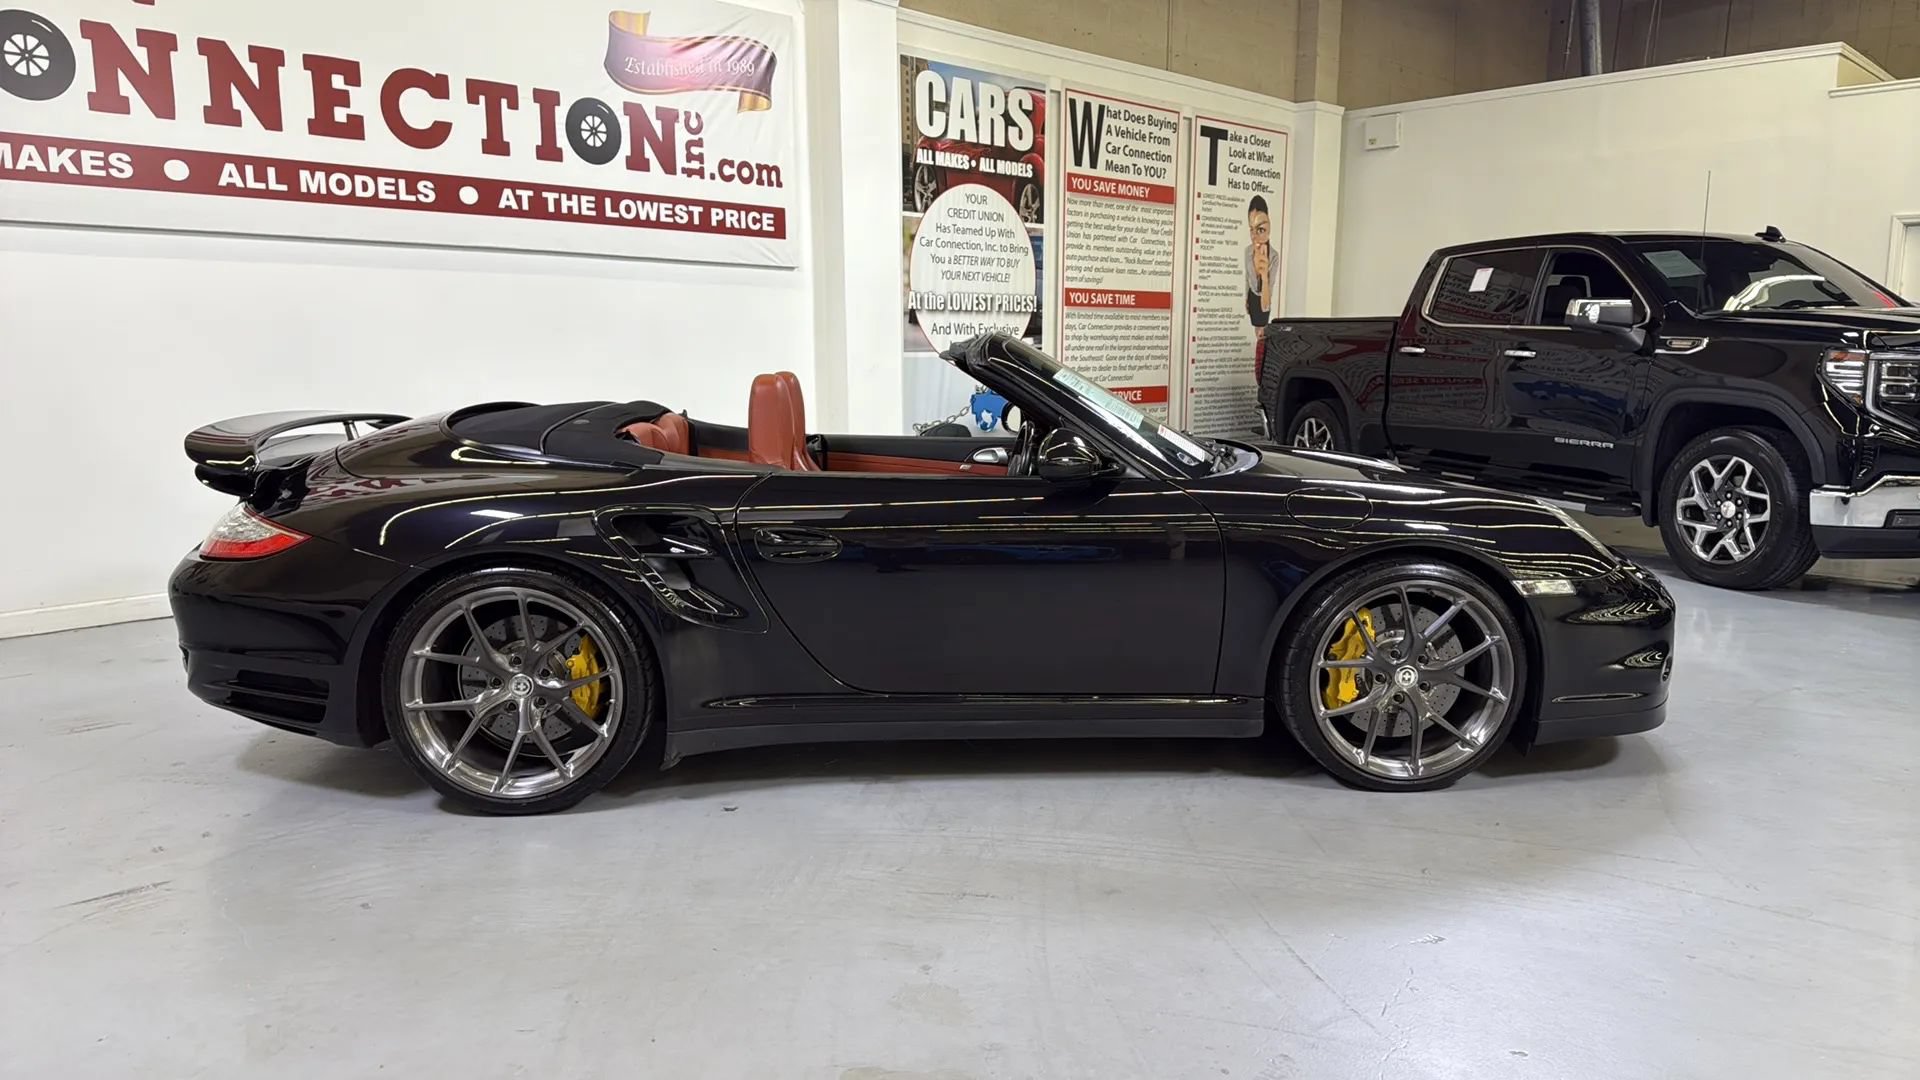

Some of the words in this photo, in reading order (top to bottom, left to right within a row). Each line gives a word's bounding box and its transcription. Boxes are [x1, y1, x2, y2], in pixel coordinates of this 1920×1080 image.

[624, 56, 704, 77] Established
[709, 60, 722, 73] in
[727, 58, 755, 76] 1989
[916, 70, 1034, 151] CARS
[1124, 109, 1146, 125] Does
[1148, 114, 1177, 133] Buying
[1106, 124, 1112, 136] A
[1115, 125, 1146, 142] Vehicle
[1148, 132, 1170, 146] From
[1244, 136, 1248, 144] a
[1249, 134, 1271, 148] Closer
[1105, 142, 1120, 155] Car
[1123, 145, 1172, 163] Connection
[1229, 146, 1246, 160] Look
[1248, 151, 1255, 161] at
[1256, 151, 1274, 164] What
[916, 148, 934, 165] ALL
[935, 151, 969, 170] MAKES
[979, 157, 995, 173] ALL
[997, 159, 1033, 178] MODELS
[1105, 159, 1130, 174] Mean
[1132, 163, 1142, 176] To
[1143, 165, 1167, 179] YOU?
[1228, 162, 1240, 174] Car
[1242, 165, 1280, 180] Connection
[709, 158, 783, 188] .com
[1071, 177, 1091, 191] YOU
[1093, 180, 1116, 194] SAVE
[1118, 183, 1150, 198] MONEY
[1228, 178, 1241, 189] Has
[1242, 180, 1250, 190] to
[218, 163, 289, 191] ALL
[300, 169, 436, 204] MODELS
[499, 187, 535, 211] AT
[542, 191, 597, 217] THE
[605, 197, 703, 227] LOWEST
[710, 206, 776, 232] PRICE
[965, 193, 988, 205] YOUR
[947, 207, 976, 220] CREDIT
[978, 211, 1004, 222] UNION
[936, 223, 951, 234] Has
[952, 224, 983, 236] Teamed
[985, 226, 996, 238] Up
[997, 228, 1015, 239] With
[919, 237, 933, 247] Car
[935, 238, 983, 252] Connection,
[985, 242, 998, 252] Inc.
[1000, 243, 1008, 253] to
[1009, 244, 1029, 256] Bring
[930, 254, 946, 265] You
[948, 257, 952, 265] a
[953, 255, 979, 266] BETTER
[980, 256, 995, 267] WAY
[996, 257, 1006, 268] TO
[1006, 258, 1020, 269] BUY
[941, 270, 961, 281] YOUR
[962, 271, 980, 281] NEXT
[981, 272, 1010, 283] VEHICLE!
[908, 292, 922, 310] At
[925, 292, 944, 311] the
[947, 293, 992, 312] LOWEST
[995, 295, 1037, 312] PRICES!
[1069, 292, 1089, 304] YOU
[1090, 293, 1114, 305] SAVE
[1115, 294, 1136, 305] TIME
[931, 322, 951, 335] And
[954, 322, 976, 336] With
[1554, 437, 1614, 449] SIERRA
